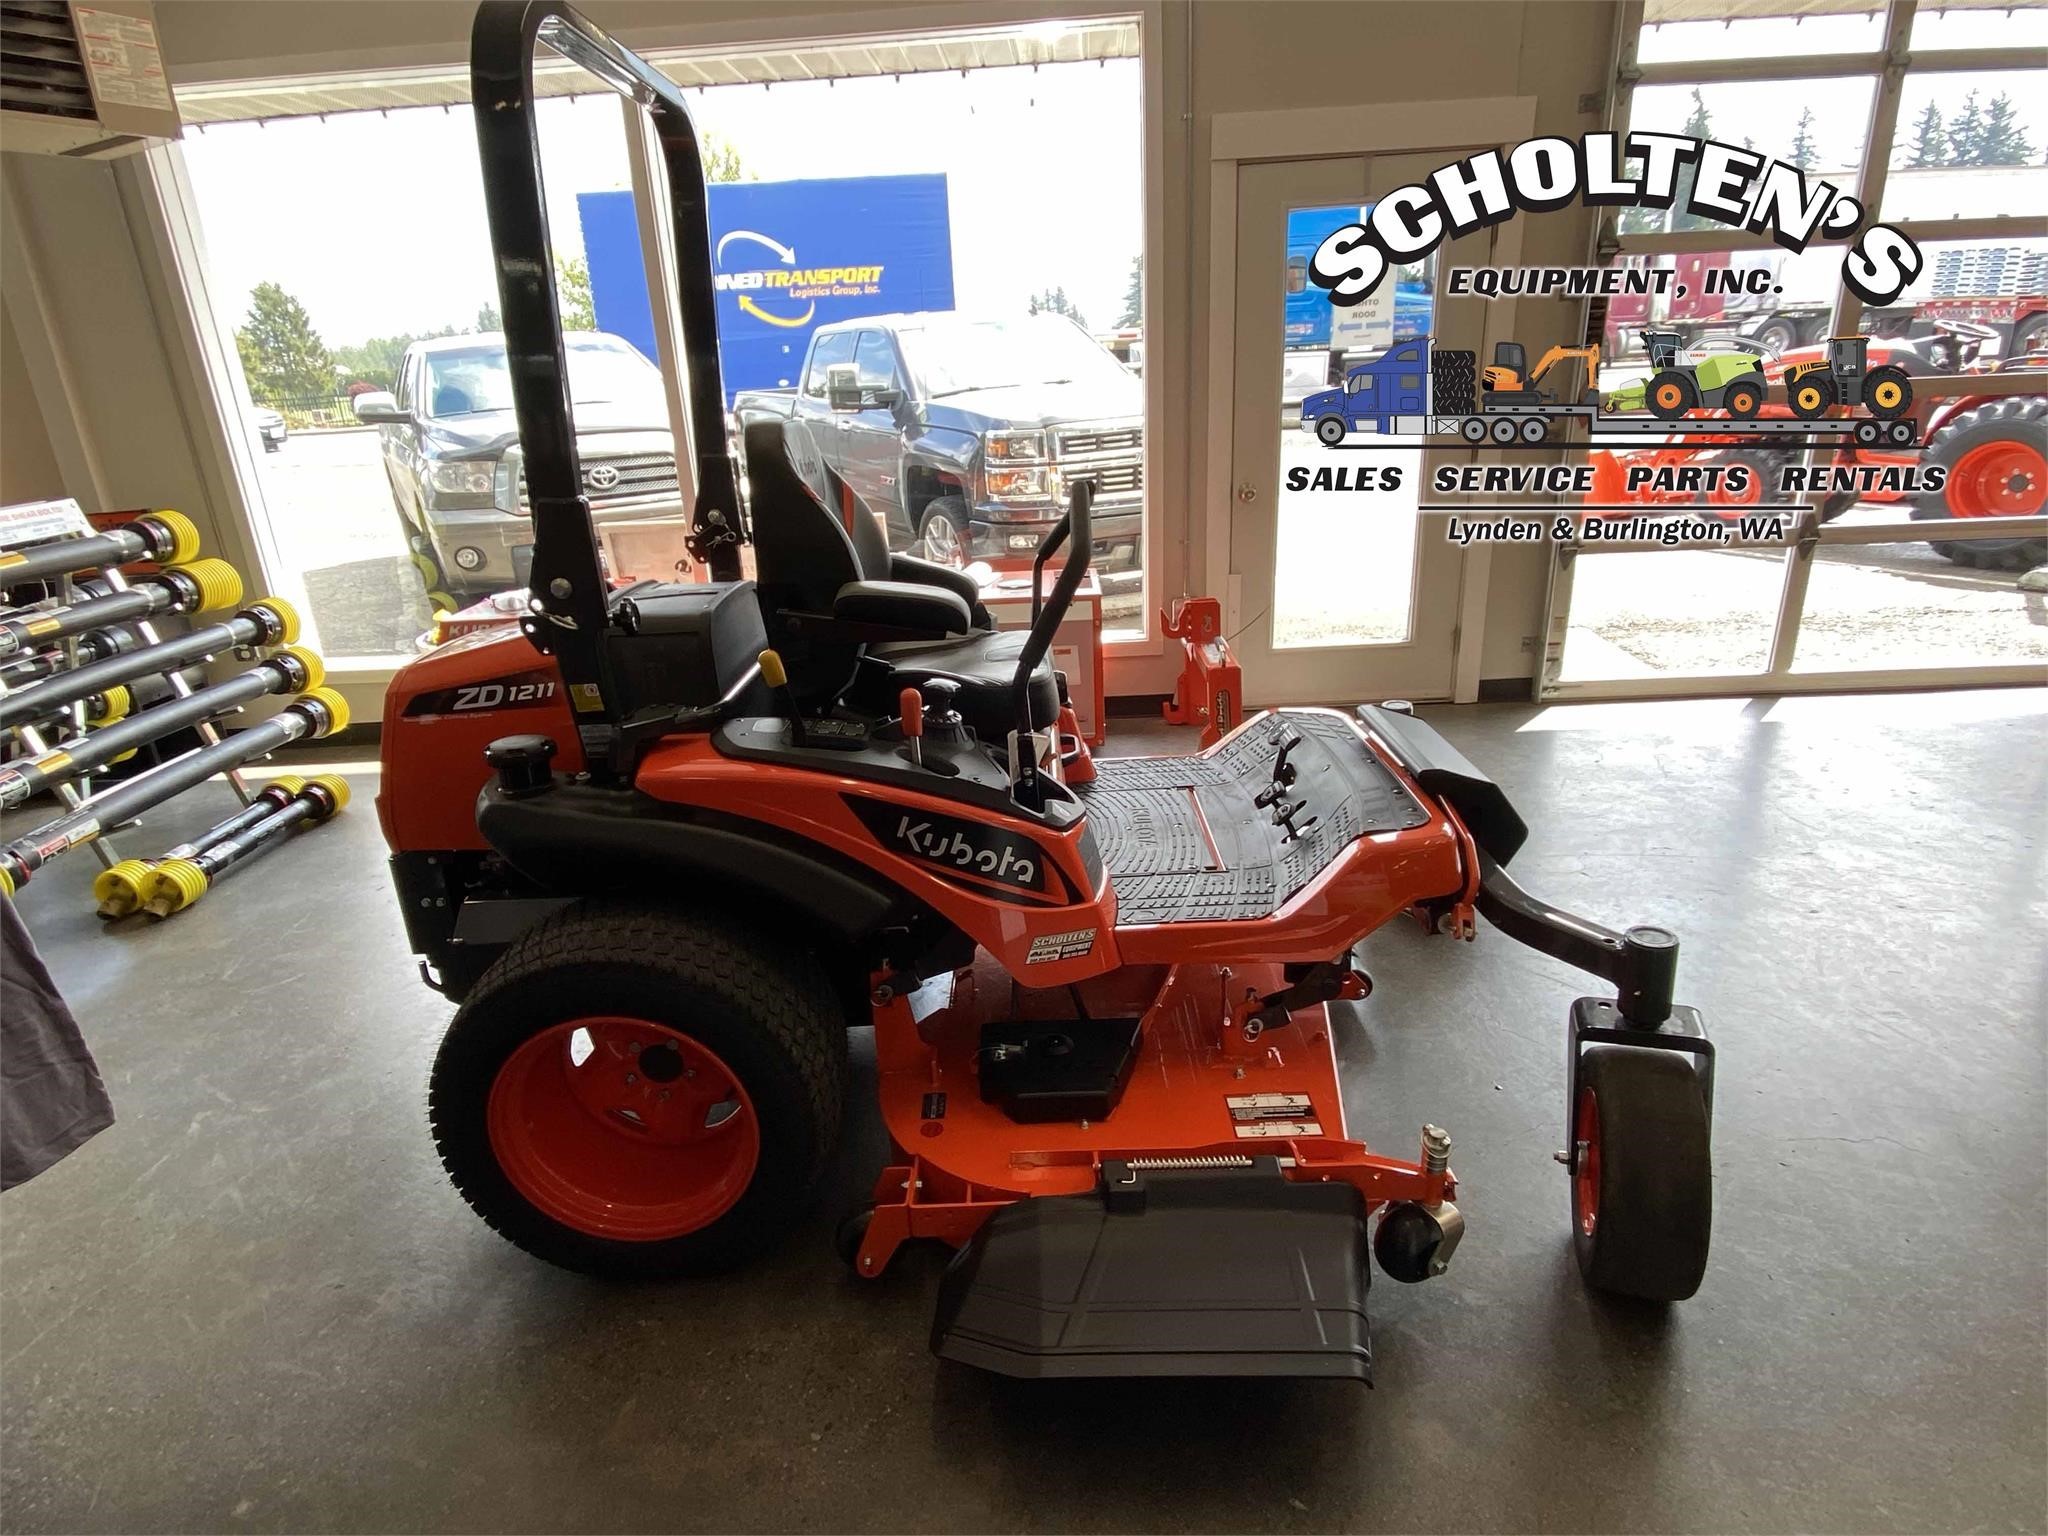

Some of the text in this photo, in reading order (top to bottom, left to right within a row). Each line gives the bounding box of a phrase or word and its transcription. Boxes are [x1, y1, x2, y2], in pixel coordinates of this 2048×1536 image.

[764, 266, 885, 287] TRANSPORT
[789, 284, 880, 299] Logistics Group, Inc.
[896, 816, 1034, 883] Kubota
